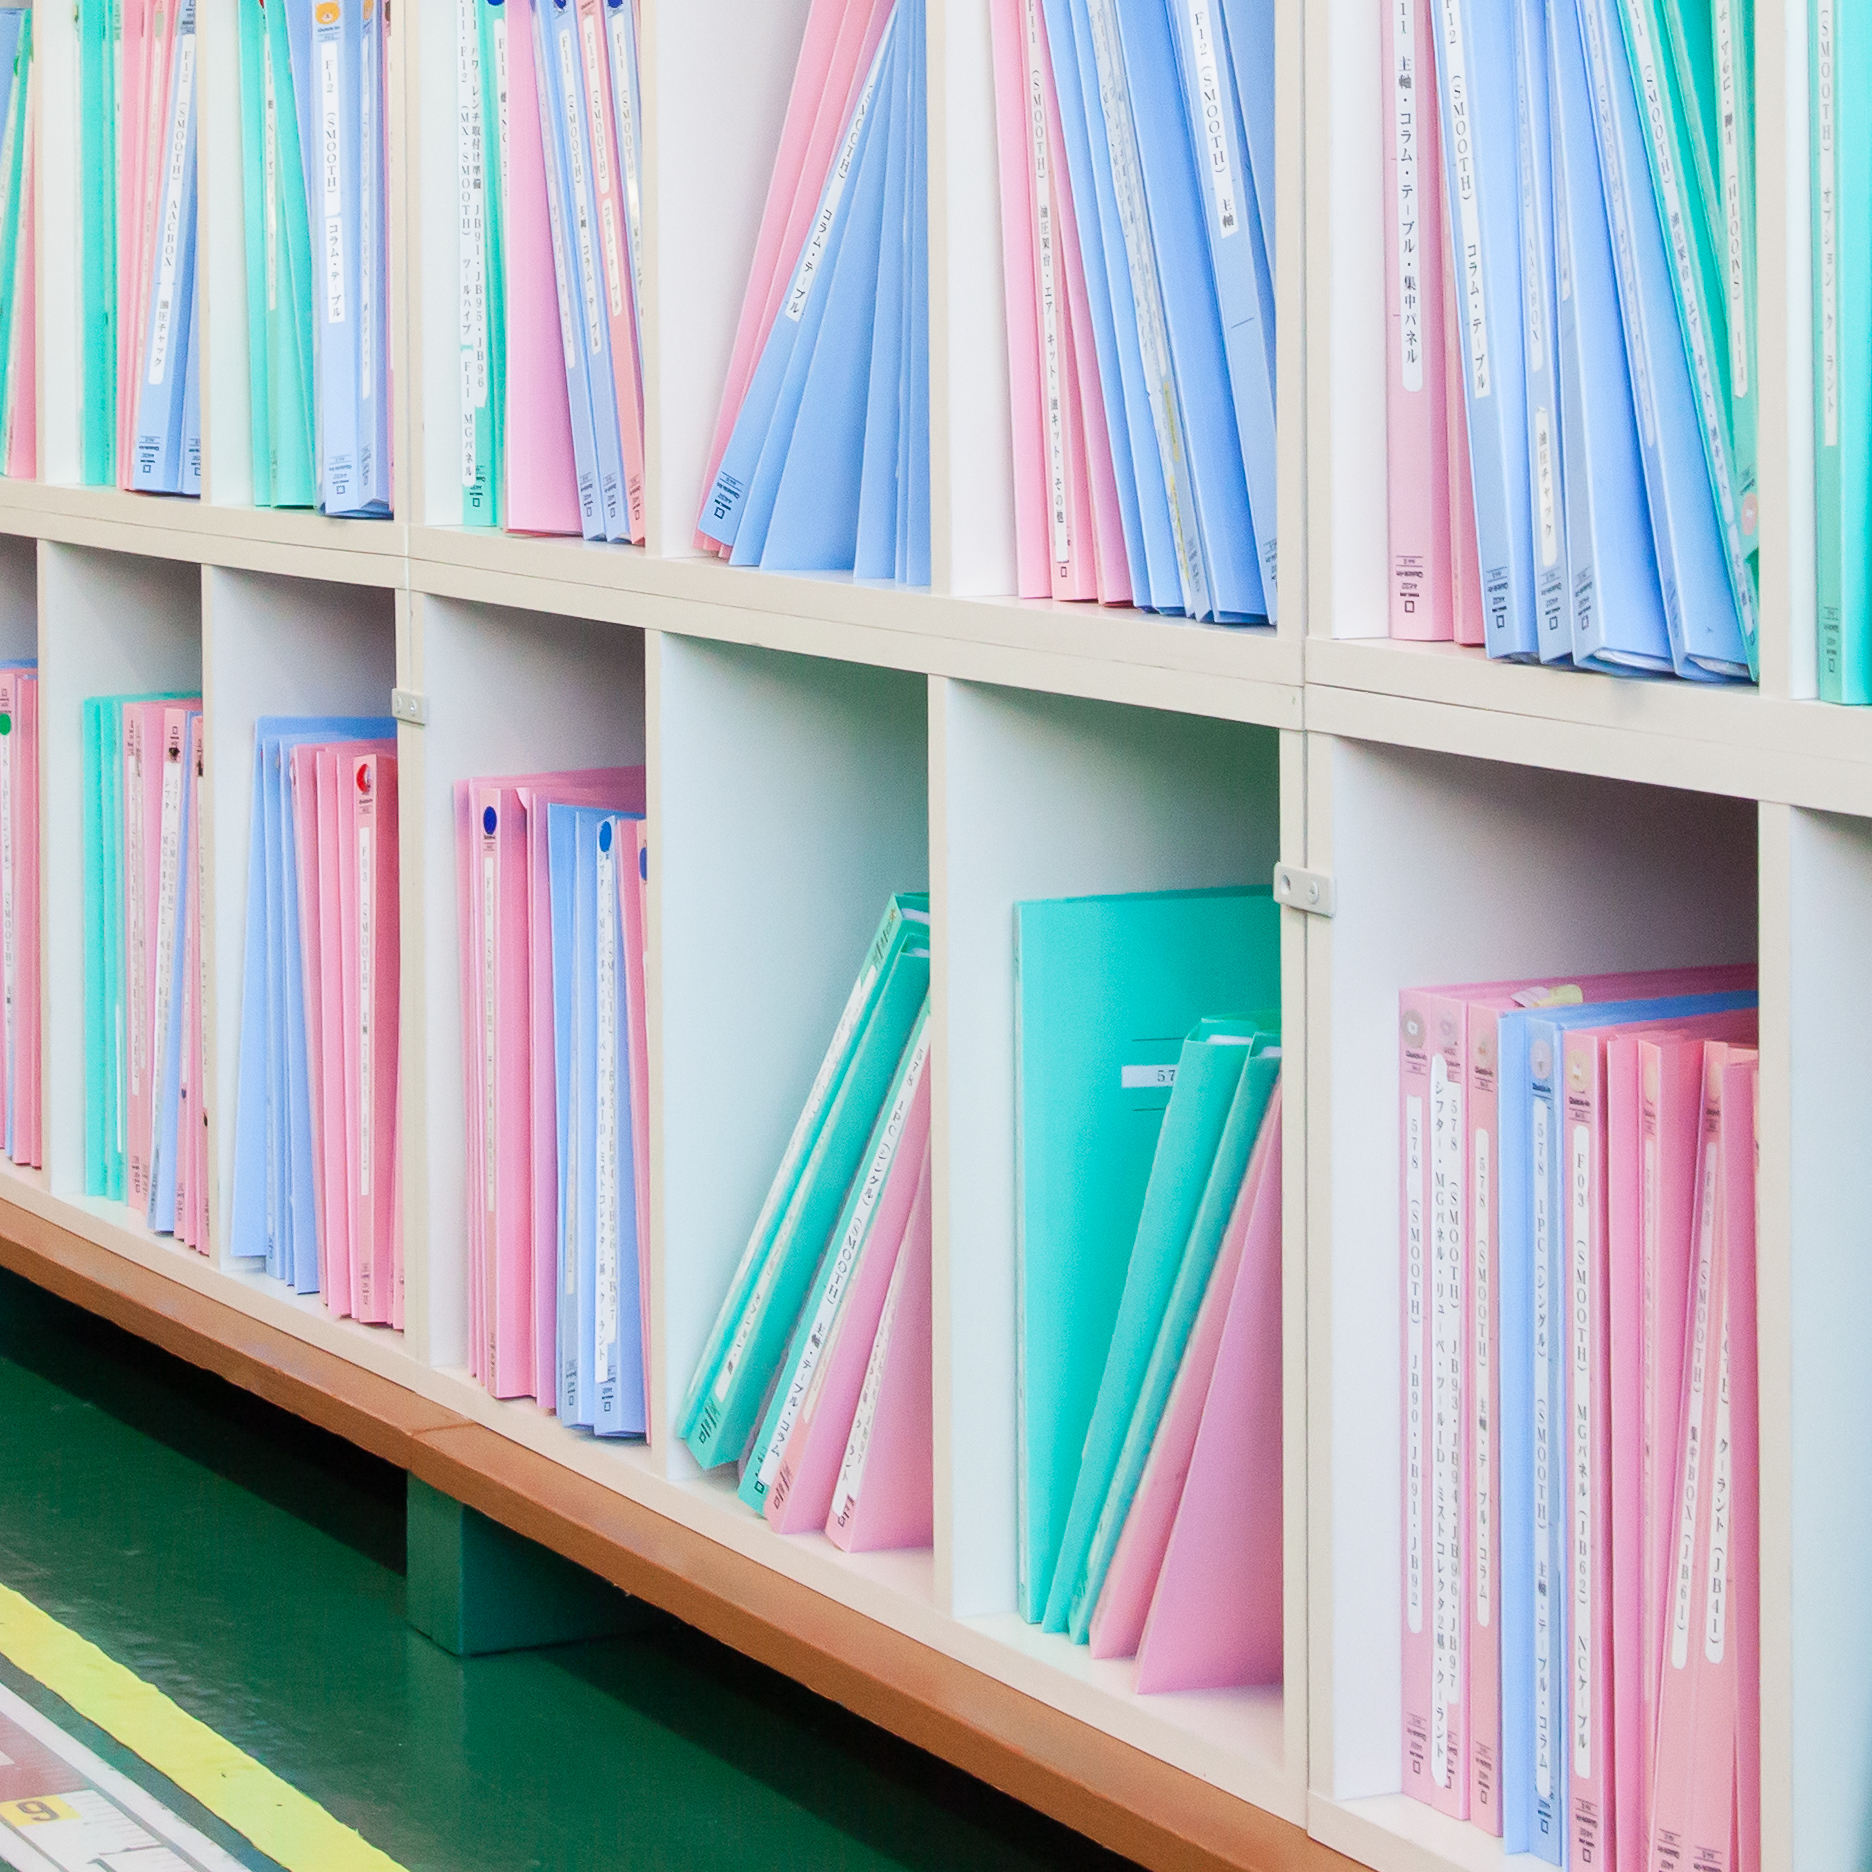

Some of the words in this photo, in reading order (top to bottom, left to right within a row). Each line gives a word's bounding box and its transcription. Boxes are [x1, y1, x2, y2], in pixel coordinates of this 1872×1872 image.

[1450, 74, 1472, 202] (SMOOTH)
[1644, 65, 1674, 185] (SMOOTH)
[1576, 1152, 1587, 1210] F03
[1410, 1200, 1422, 1325] (SMOOTH)
[1448, 1180, 1461, 1310] (SMOOTH)
[1575, 1238, 1588, 1372] (SMOOTH)
